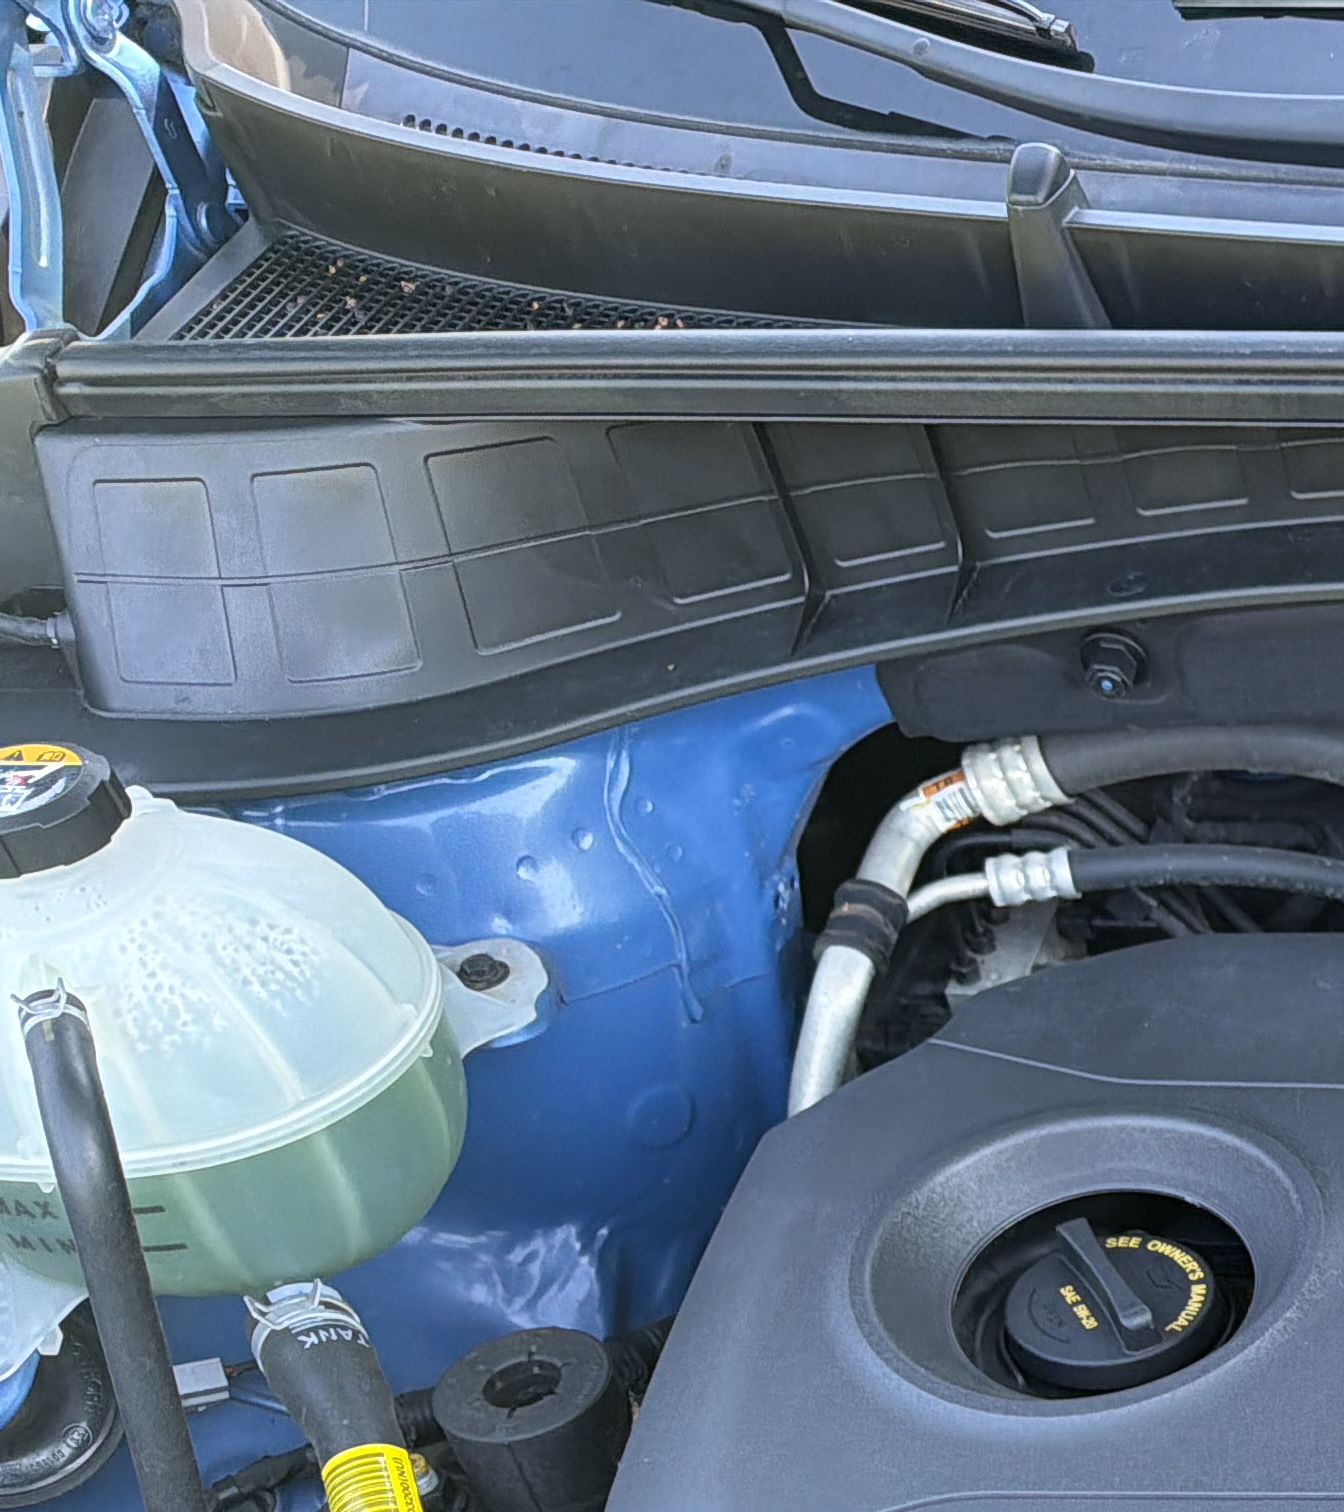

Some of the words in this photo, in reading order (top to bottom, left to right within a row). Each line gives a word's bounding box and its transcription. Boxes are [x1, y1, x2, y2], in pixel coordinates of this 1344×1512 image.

[7, 1232, 77, 1254] MIN
[1105, 1236, 1142, 1249] SEE
[1147, 1239, 1204, 1281] OWNER'S
[1059, 1285, 1080, 1306] SAE
[1164, 1284, 1207, 1332] MANUAL
[297, 1327, 370, 1349] TANK
